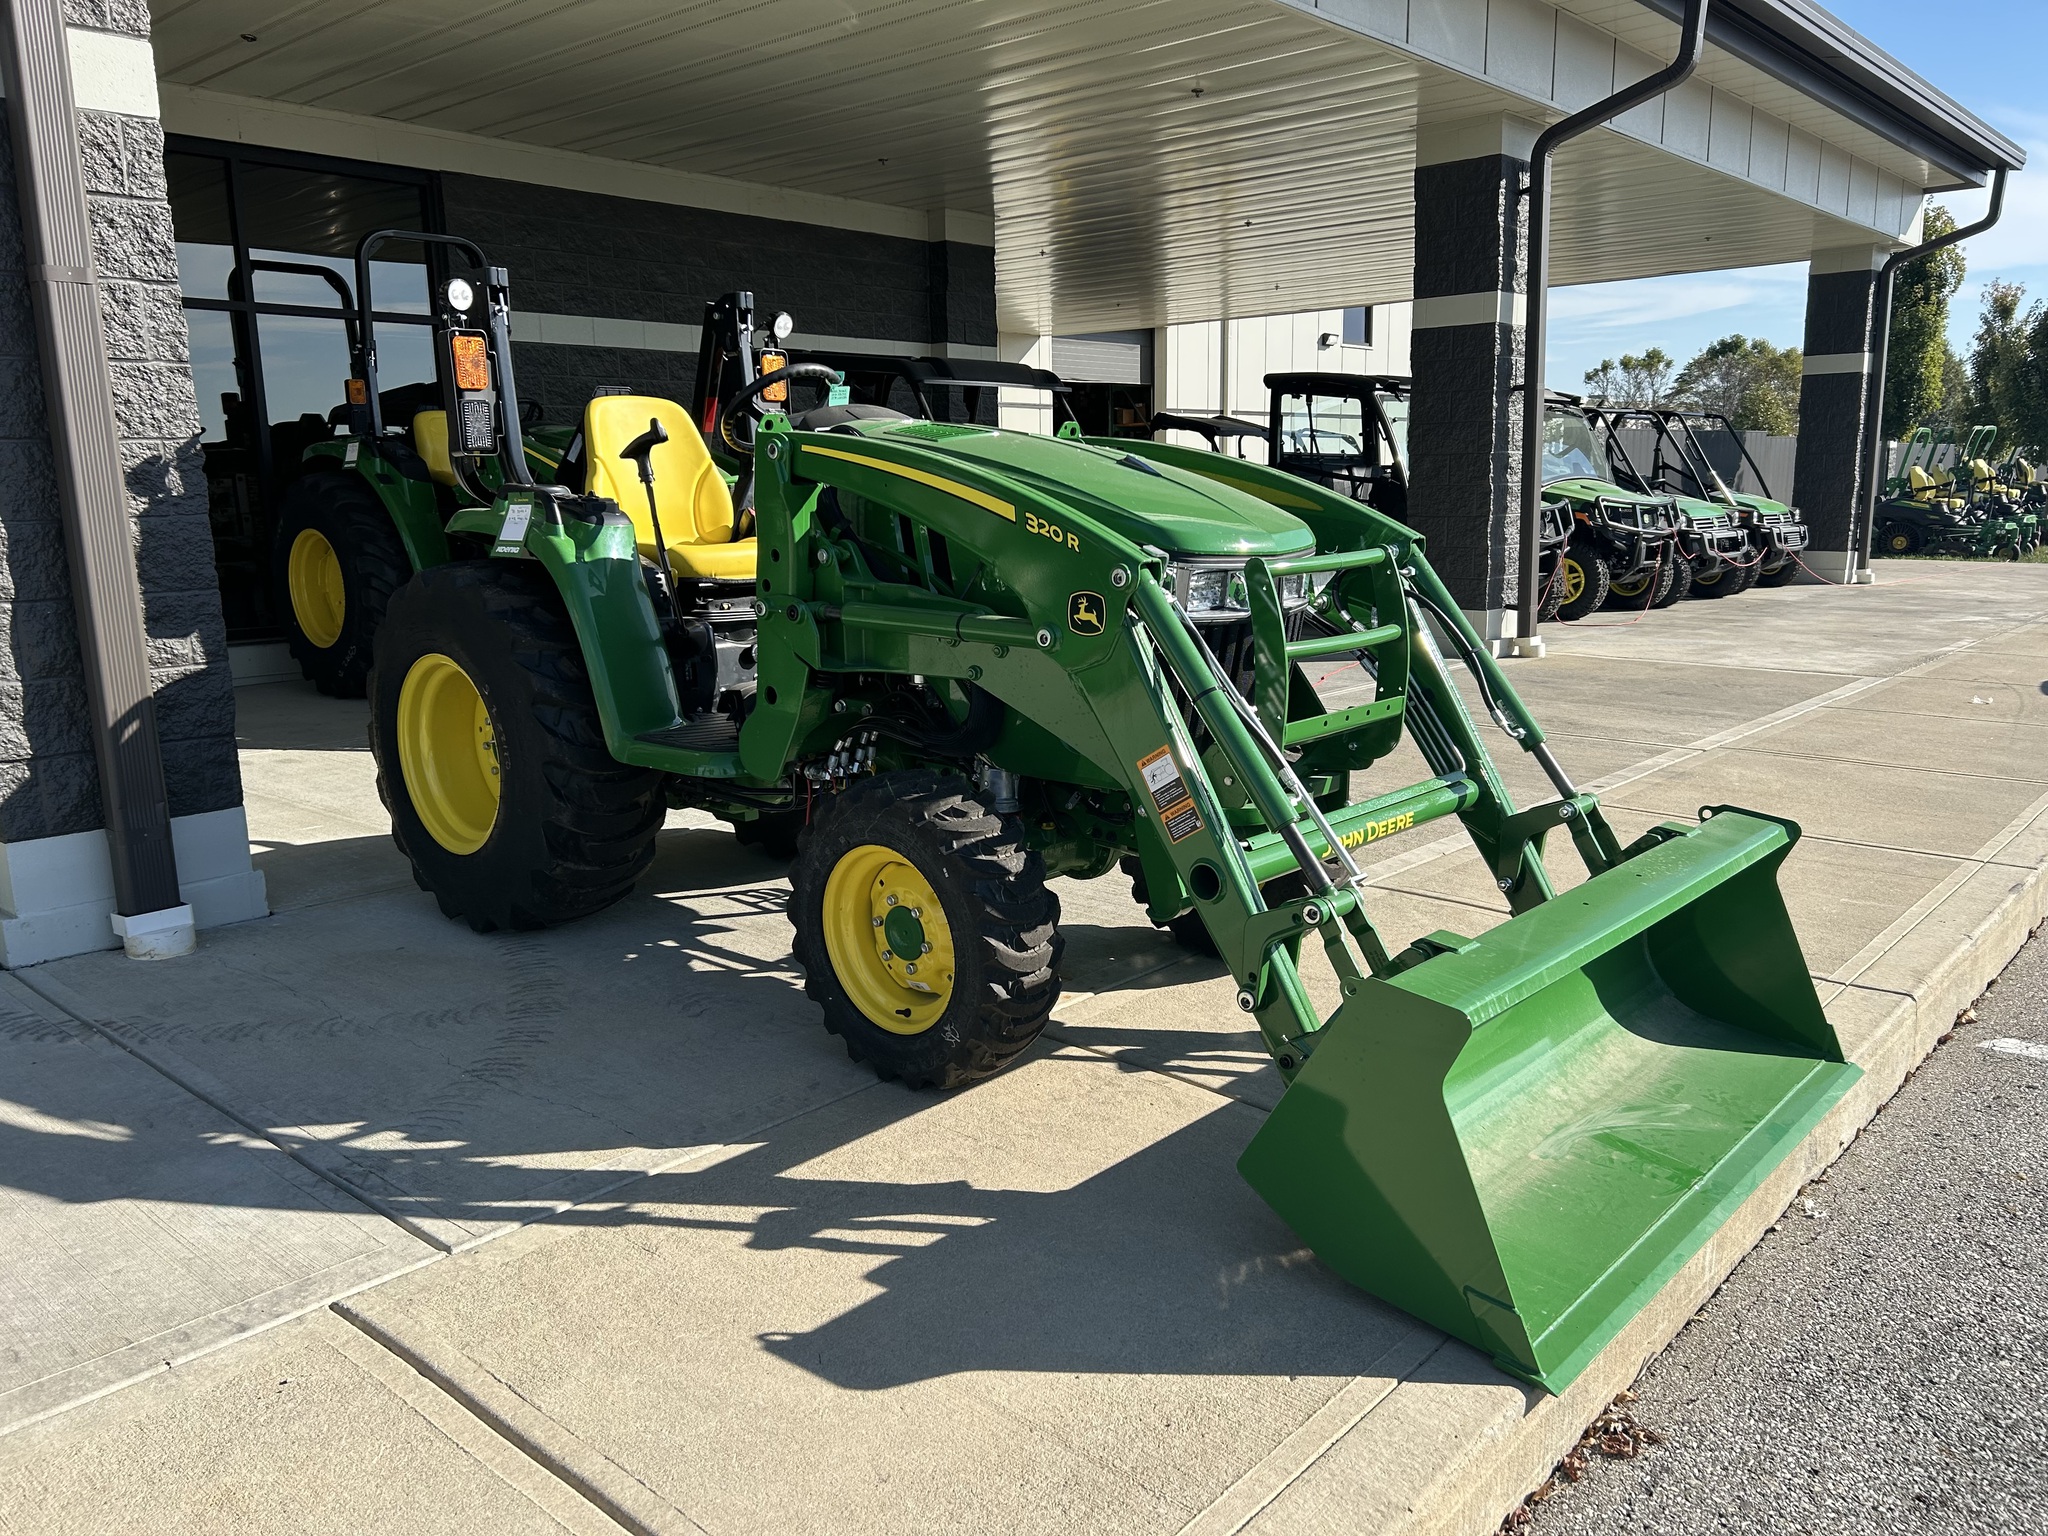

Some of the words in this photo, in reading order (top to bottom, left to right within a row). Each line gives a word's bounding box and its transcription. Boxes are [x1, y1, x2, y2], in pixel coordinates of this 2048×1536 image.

[1025, 512, 1063, 543] 320
[1067, 532, 1080, 553] R
[1146, 748, 1167, 764] WARNING
[1169, 802, 1191, 817] WARNING
[1366, 811, 1414, 842] DEERE
